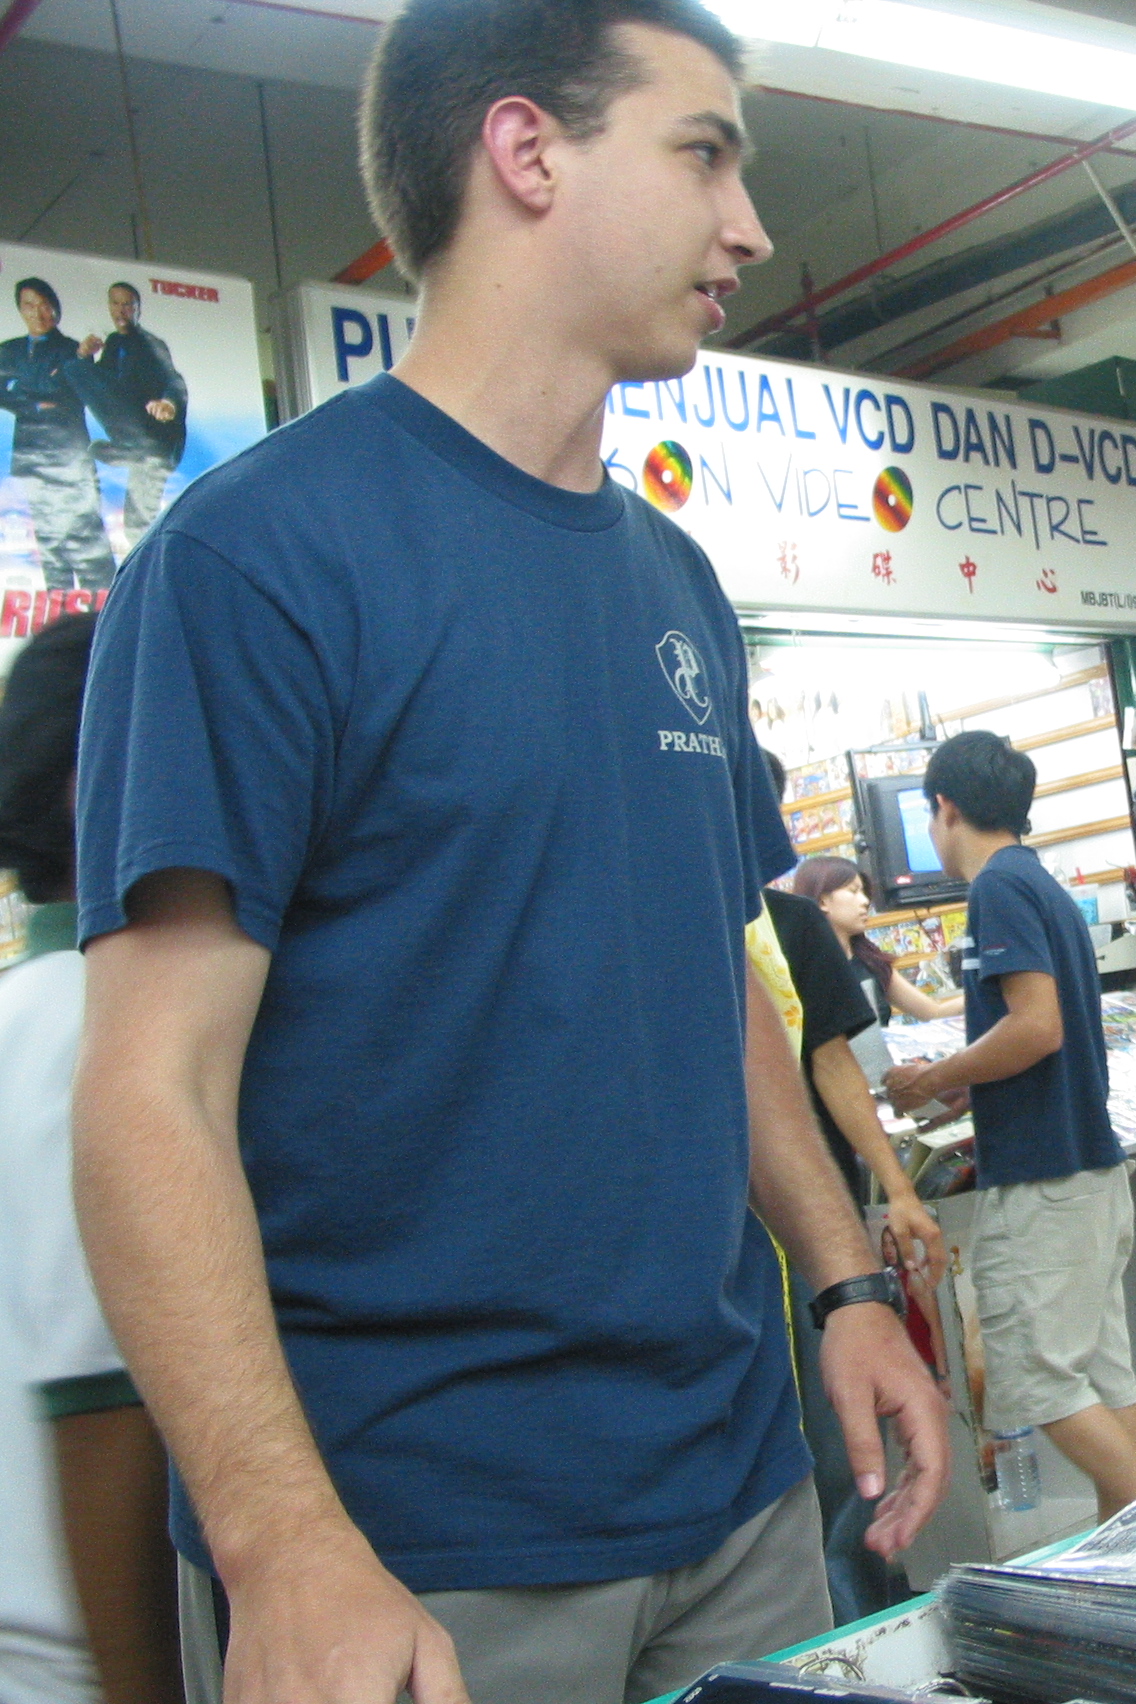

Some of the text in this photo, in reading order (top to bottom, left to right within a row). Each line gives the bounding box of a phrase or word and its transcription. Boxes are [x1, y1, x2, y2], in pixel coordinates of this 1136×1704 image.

[148, 278, 219, 303] TUCKER
[821, 383, 916, 454] VCD
[930, 400, 1017, 470] DAN
[935, 478, 1108, 551] CENTRE
